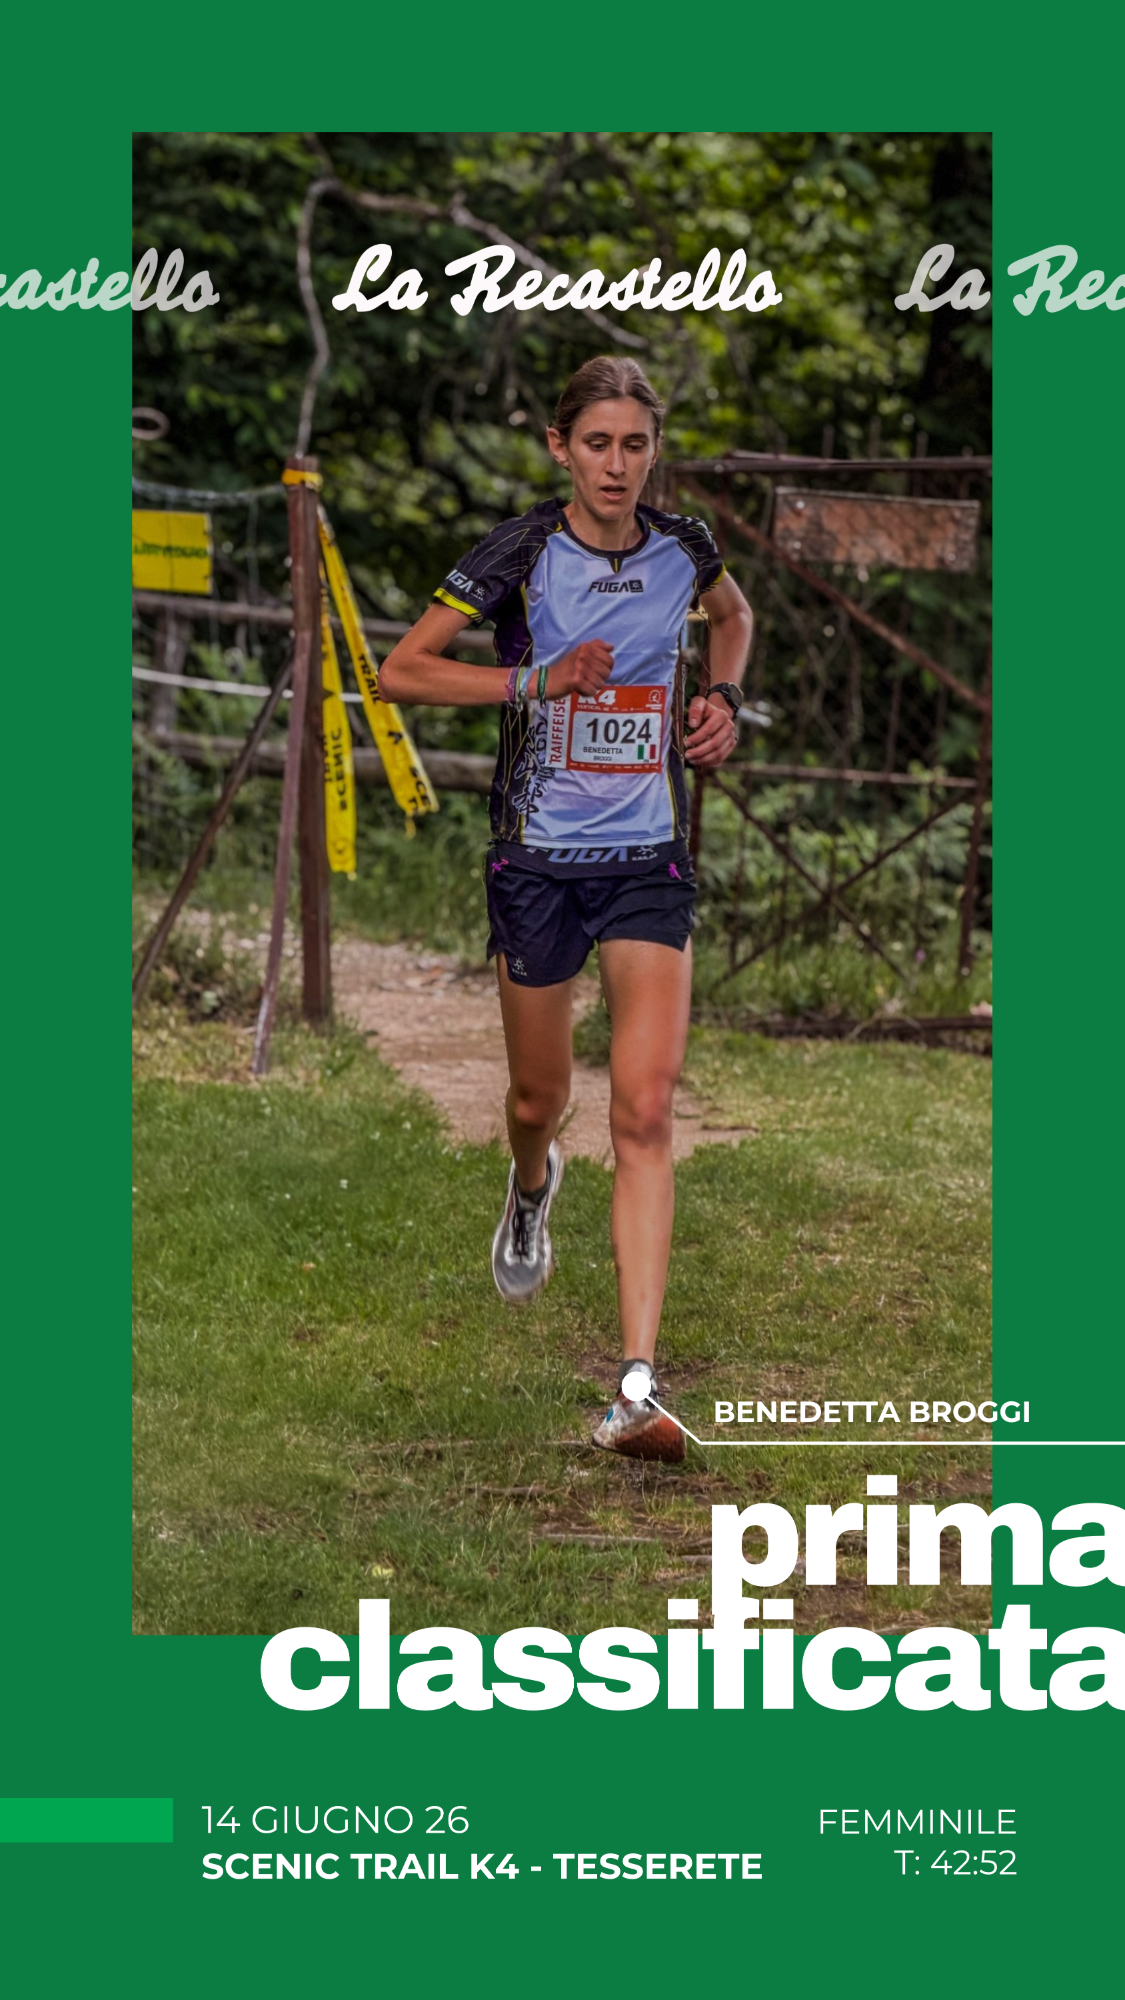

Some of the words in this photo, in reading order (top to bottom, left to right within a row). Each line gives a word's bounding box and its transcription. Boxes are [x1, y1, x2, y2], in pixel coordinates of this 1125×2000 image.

[588, 581, 630, 593] FUGA
[586, 717, 652, 744] 1024
[583, 746, 623, 755] BENEDETTA
